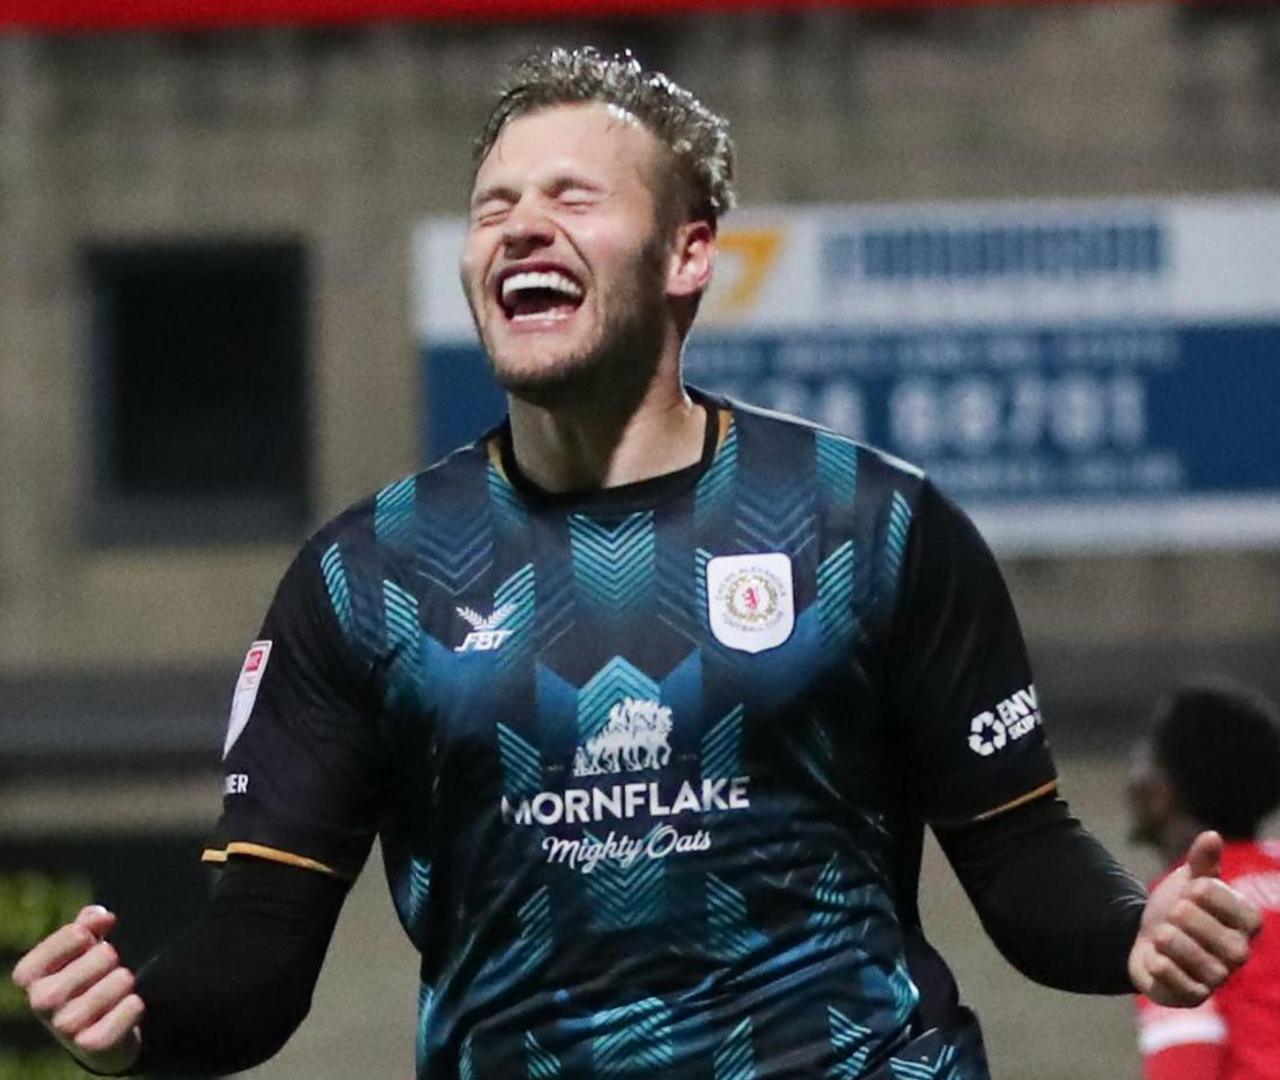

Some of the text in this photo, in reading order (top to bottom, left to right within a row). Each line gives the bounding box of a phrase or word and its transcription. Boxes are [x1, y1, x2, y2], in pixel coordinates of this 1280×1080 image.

[501, 776, 750, 825] MORNFLAKE
[542, 825, 712, 874] Mighty Oats
